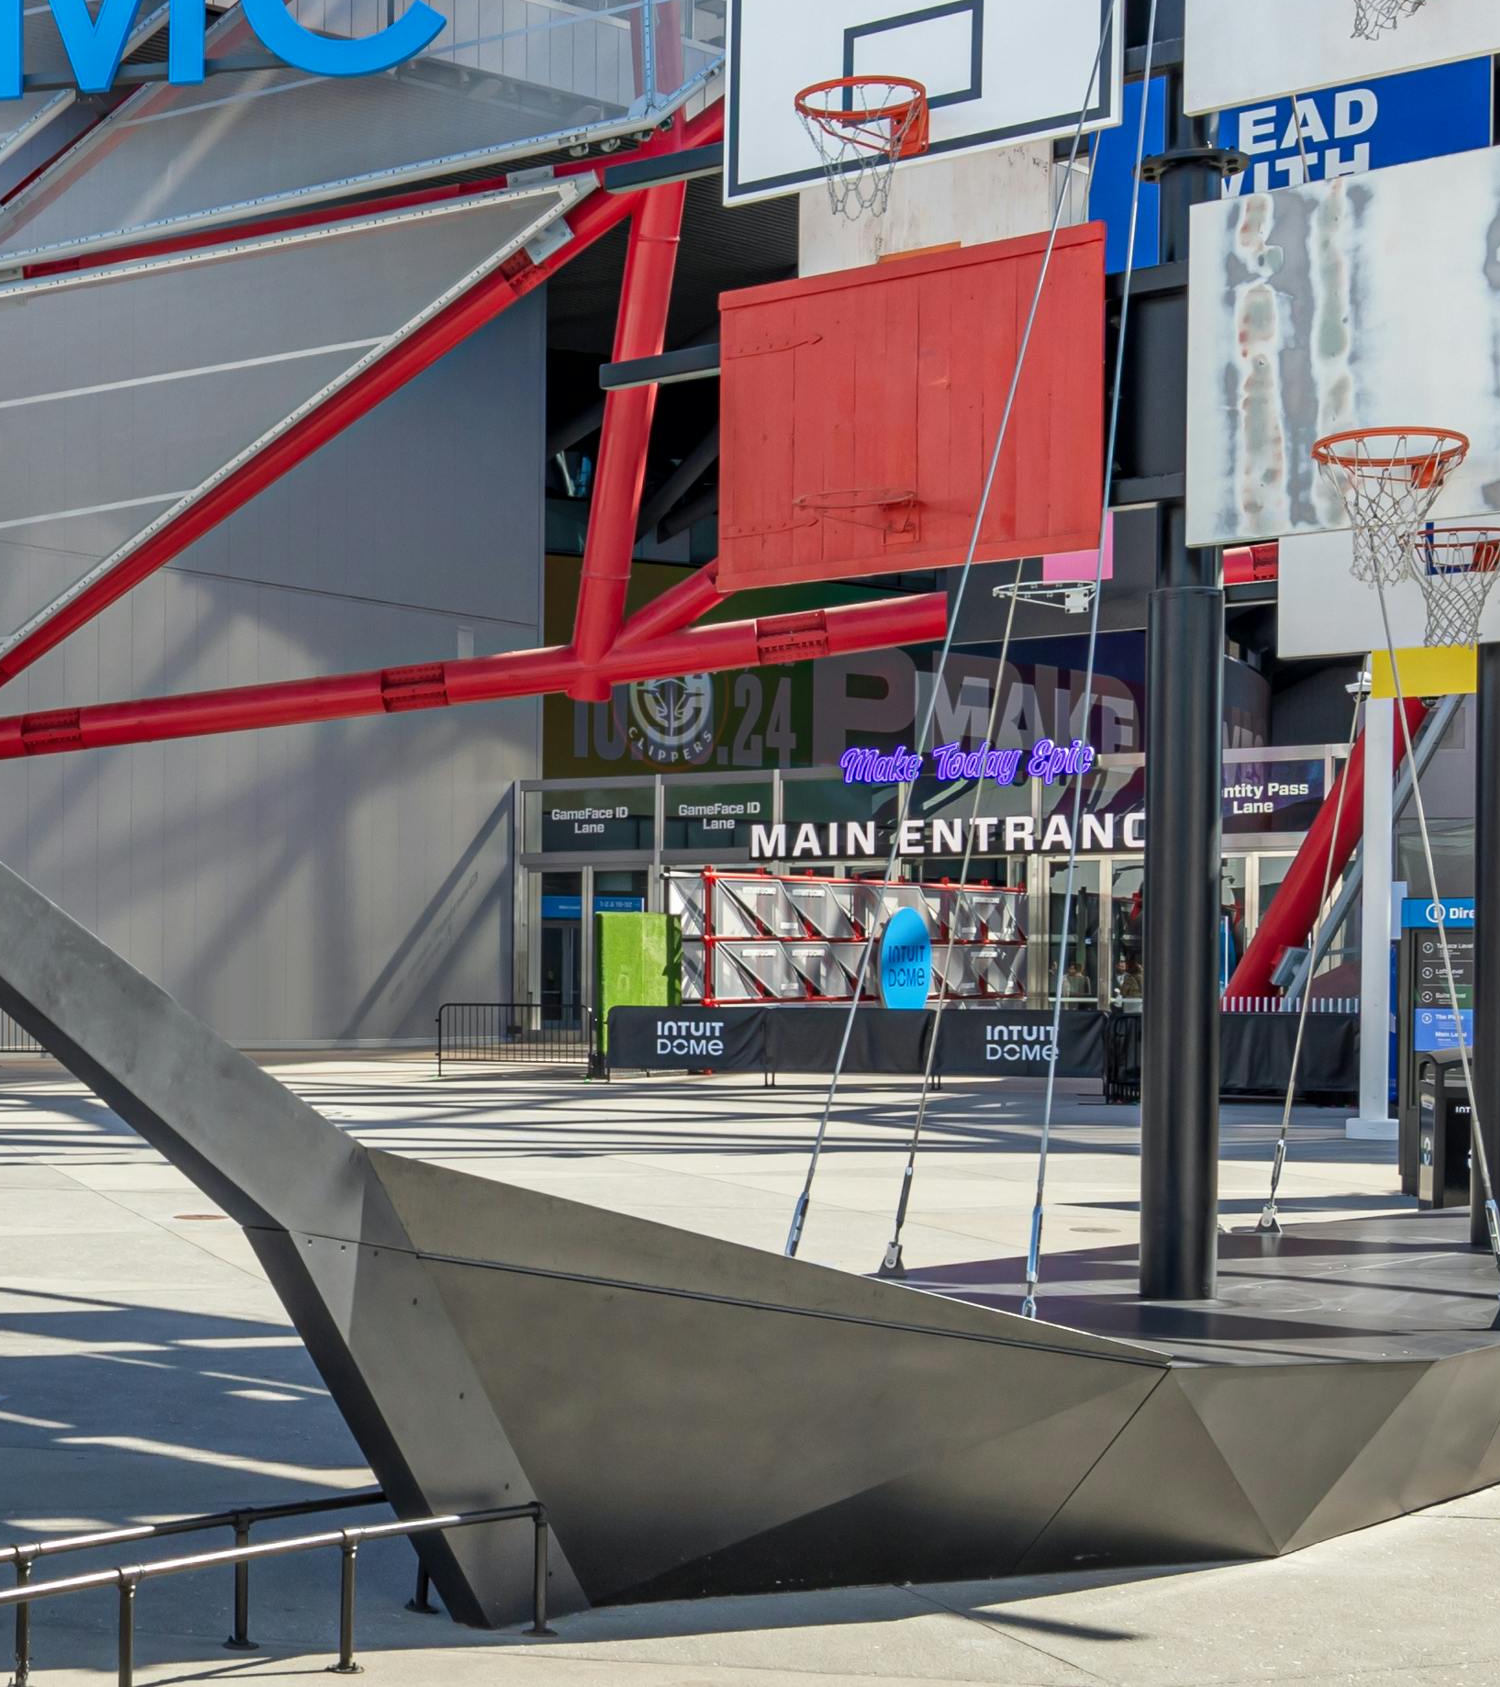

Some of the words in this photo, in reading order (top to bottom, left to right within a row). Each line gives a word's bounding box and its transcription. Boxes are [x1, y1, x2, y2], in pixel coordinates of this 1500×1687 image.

[628, 726, 713, 762] CLIPPERS
[840, 746, 923, 784] Make
[932, 741, 1023, 786] Today
[1028, 739, 1095, 785] Epic
[1221, 782, 1264, 800] ntity
[1267, 782, 1309, 797] Pass
[551, 807, 614, 820] GameFace
[615, 806, 628, 819] ID
[678, 803, 744, 817] GameFace
[746, 801, 761, 814] ID
[1232, 801, 1274, 815] Lane
[574, 821, 605, 834] Lane
[702, 818, 736, 831] Lane
[751, 820, 875, 859] MAIN
[888, 944, 925, 962] INTUIT
[888, 968, 925, 988] DOME
[656, 1021, 724, 1036] INTUIT
[985, 1025, 1058, 1041] INTUIT
[656, 1039, 724, 1055] DOME
[985, 1043, 1060, 1061] DOME
